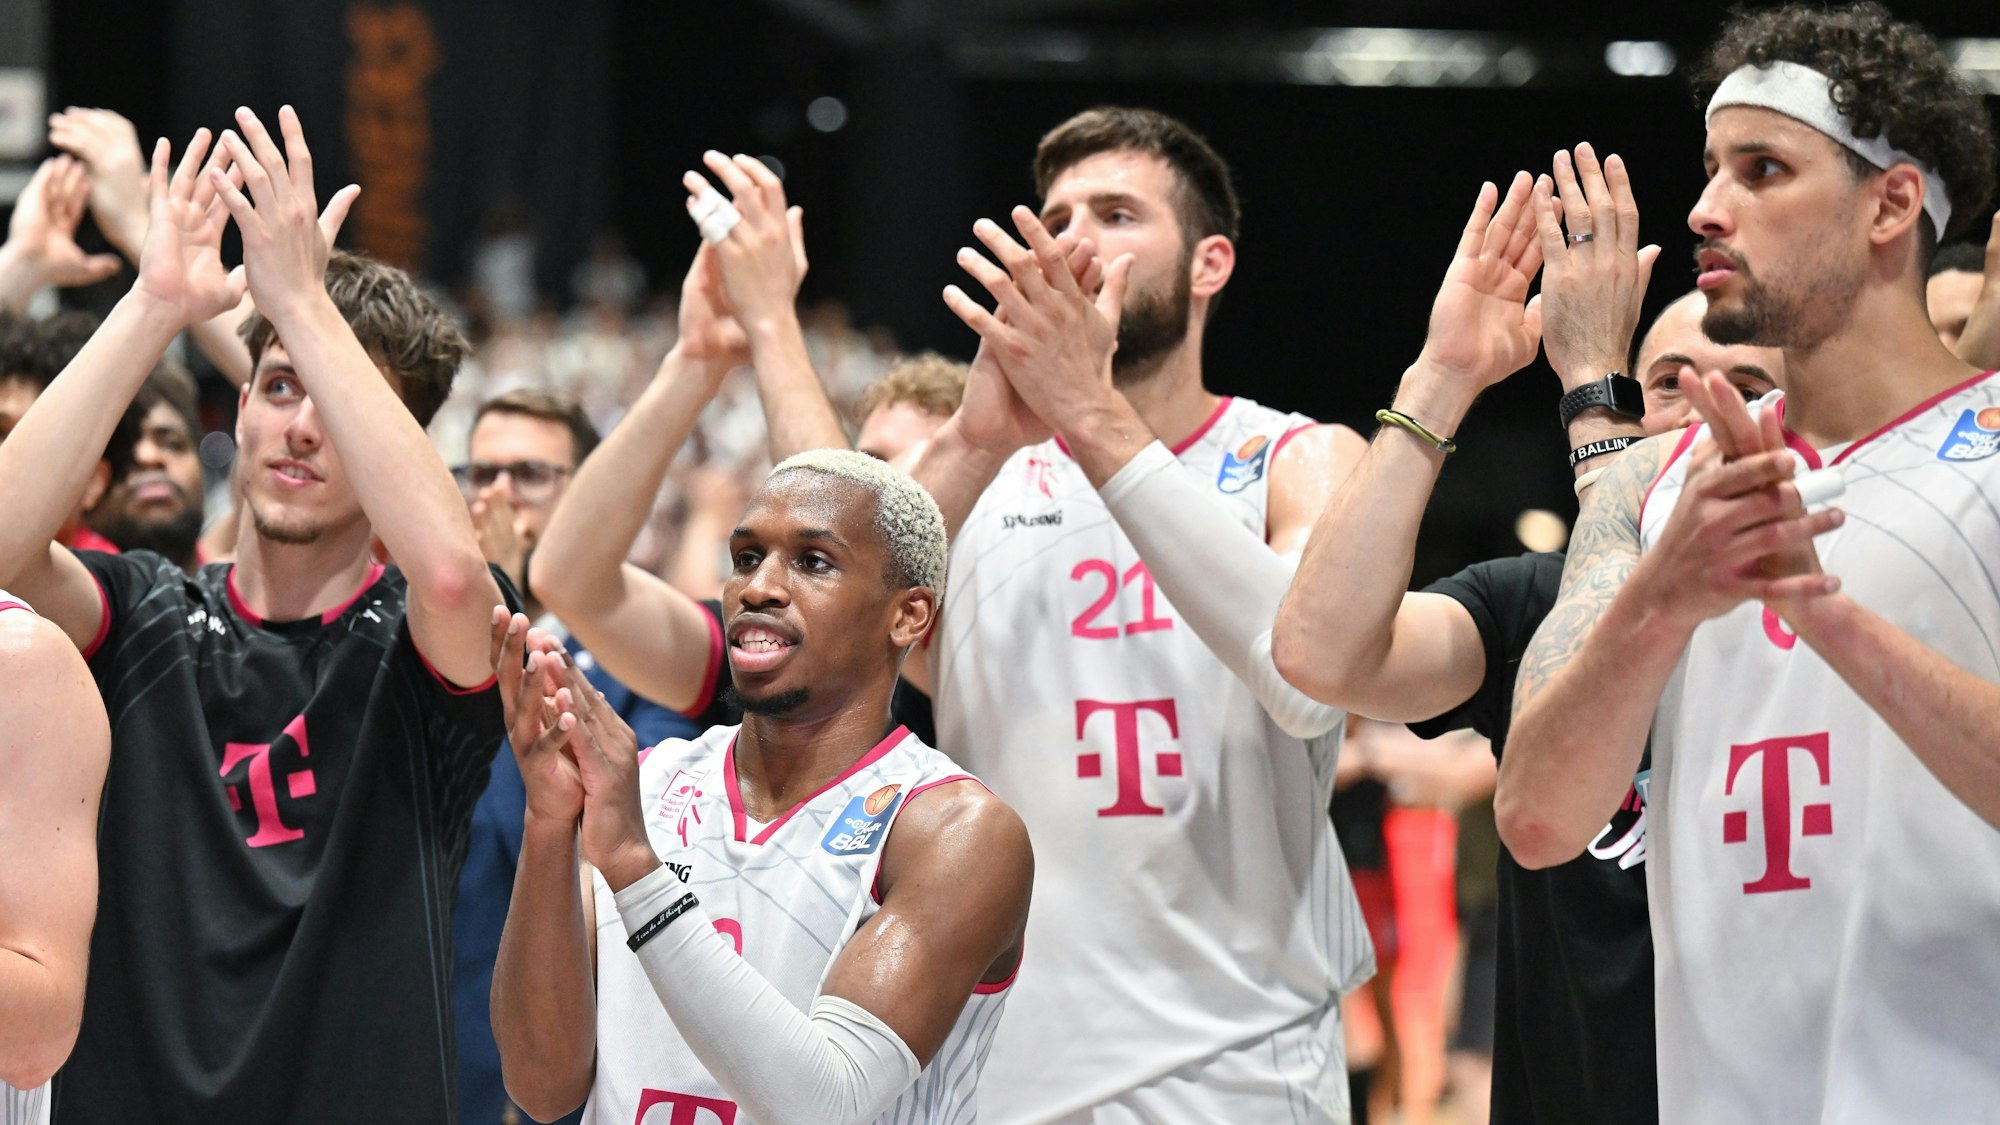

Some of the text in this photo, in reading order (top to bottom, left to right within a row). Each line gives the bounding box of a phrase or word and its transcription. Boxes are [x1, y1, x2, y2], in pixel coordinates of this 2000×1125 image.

[1577, 438, 1630, 459] BALLIN'
[1070, 558, 1173, 640] 21
[828, 832, 872, 851] BBL
